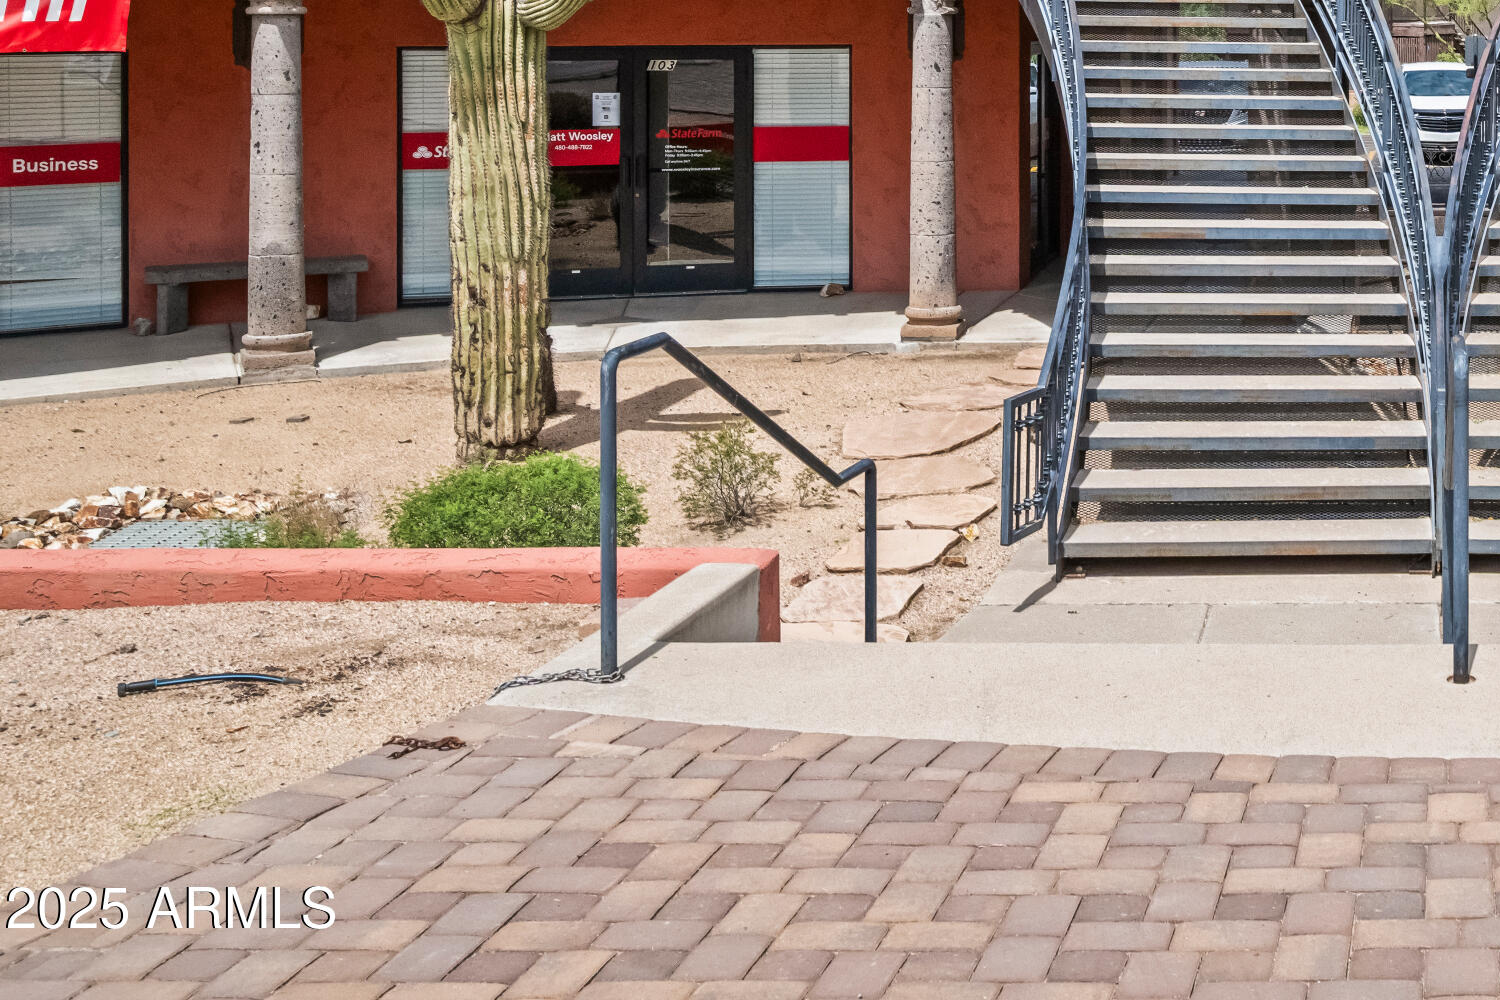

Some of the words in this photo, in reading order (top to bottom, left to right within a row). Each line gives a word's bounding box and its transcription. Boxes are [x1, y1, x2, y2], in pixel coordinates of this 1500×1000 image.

[650, 60, 675, 70] 103
[548, 132, 566, 142] att
[568, 131, 614, 142] Woosley
[12, 157, 99, 173] Business
